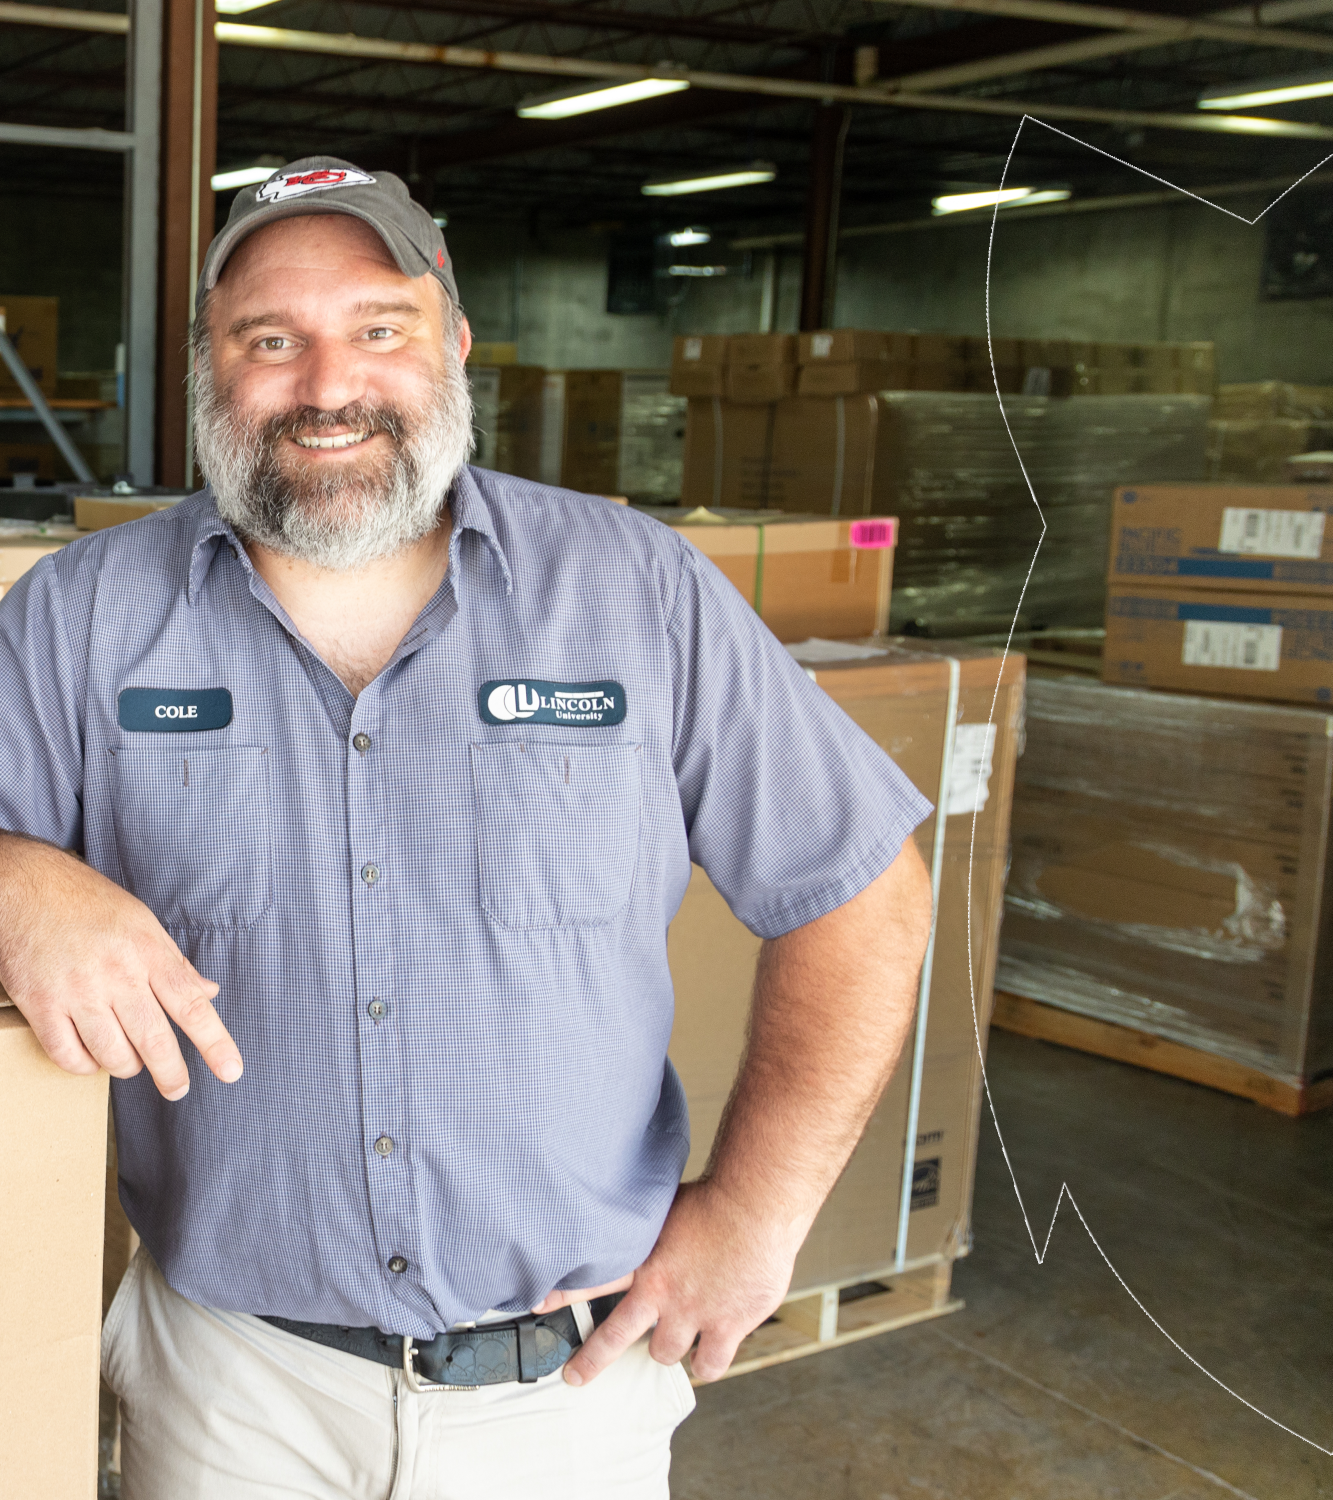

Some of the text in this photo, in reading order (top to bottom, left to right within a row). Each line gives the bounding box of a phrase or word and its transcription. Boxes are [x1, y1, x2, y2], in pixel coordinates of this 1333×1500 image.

[540, 696, 615, 712] LINCOLN
[154, 705, 198, 719] COLE
[555, 710, 604, 721] University
